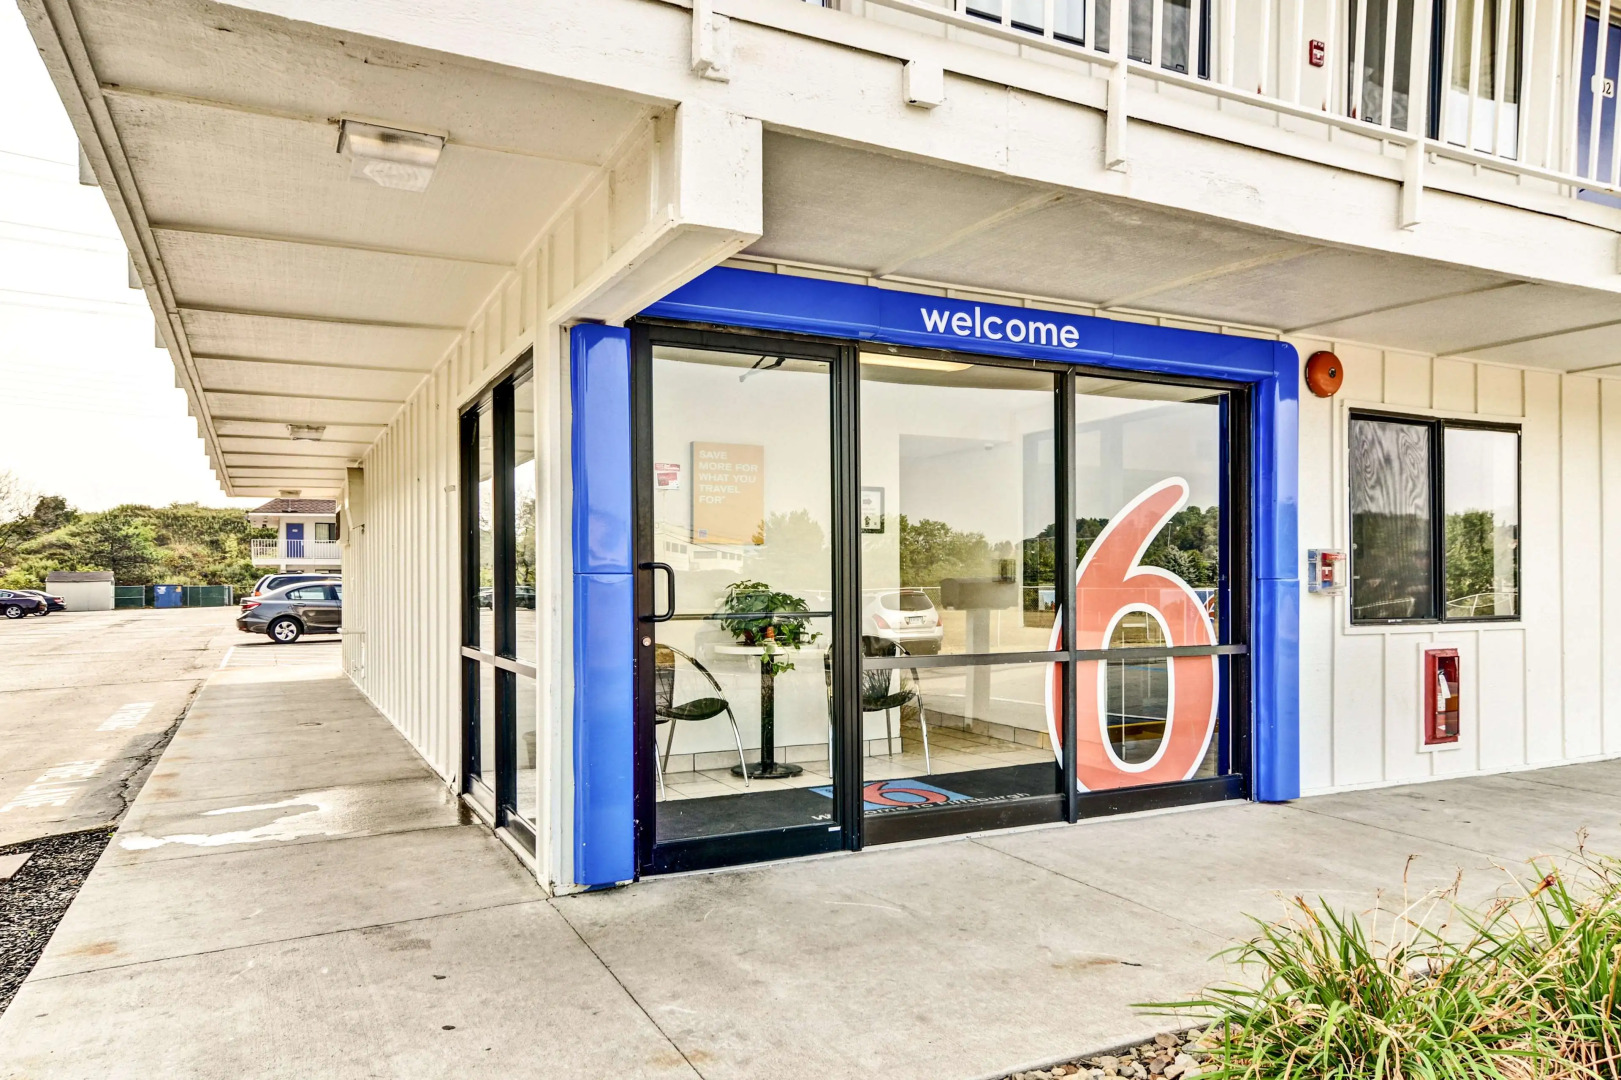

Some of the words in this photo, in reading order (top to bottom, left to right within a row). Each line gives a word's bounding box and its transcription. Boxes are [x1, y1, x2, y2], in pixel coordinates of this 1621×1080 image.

[920, 306, 1080, 348] welcome
[699, 450, 728, 460] SAVE
[698, 462, 732, 472] MORE
[735, 464, 758, 473] FOR
[698, 473, 729, 483] WHAT
[733, 475, 756, 484] YOU
[698, 484, 741, 494] TRAVEL
[1045, 476, 1219, 794] 6
